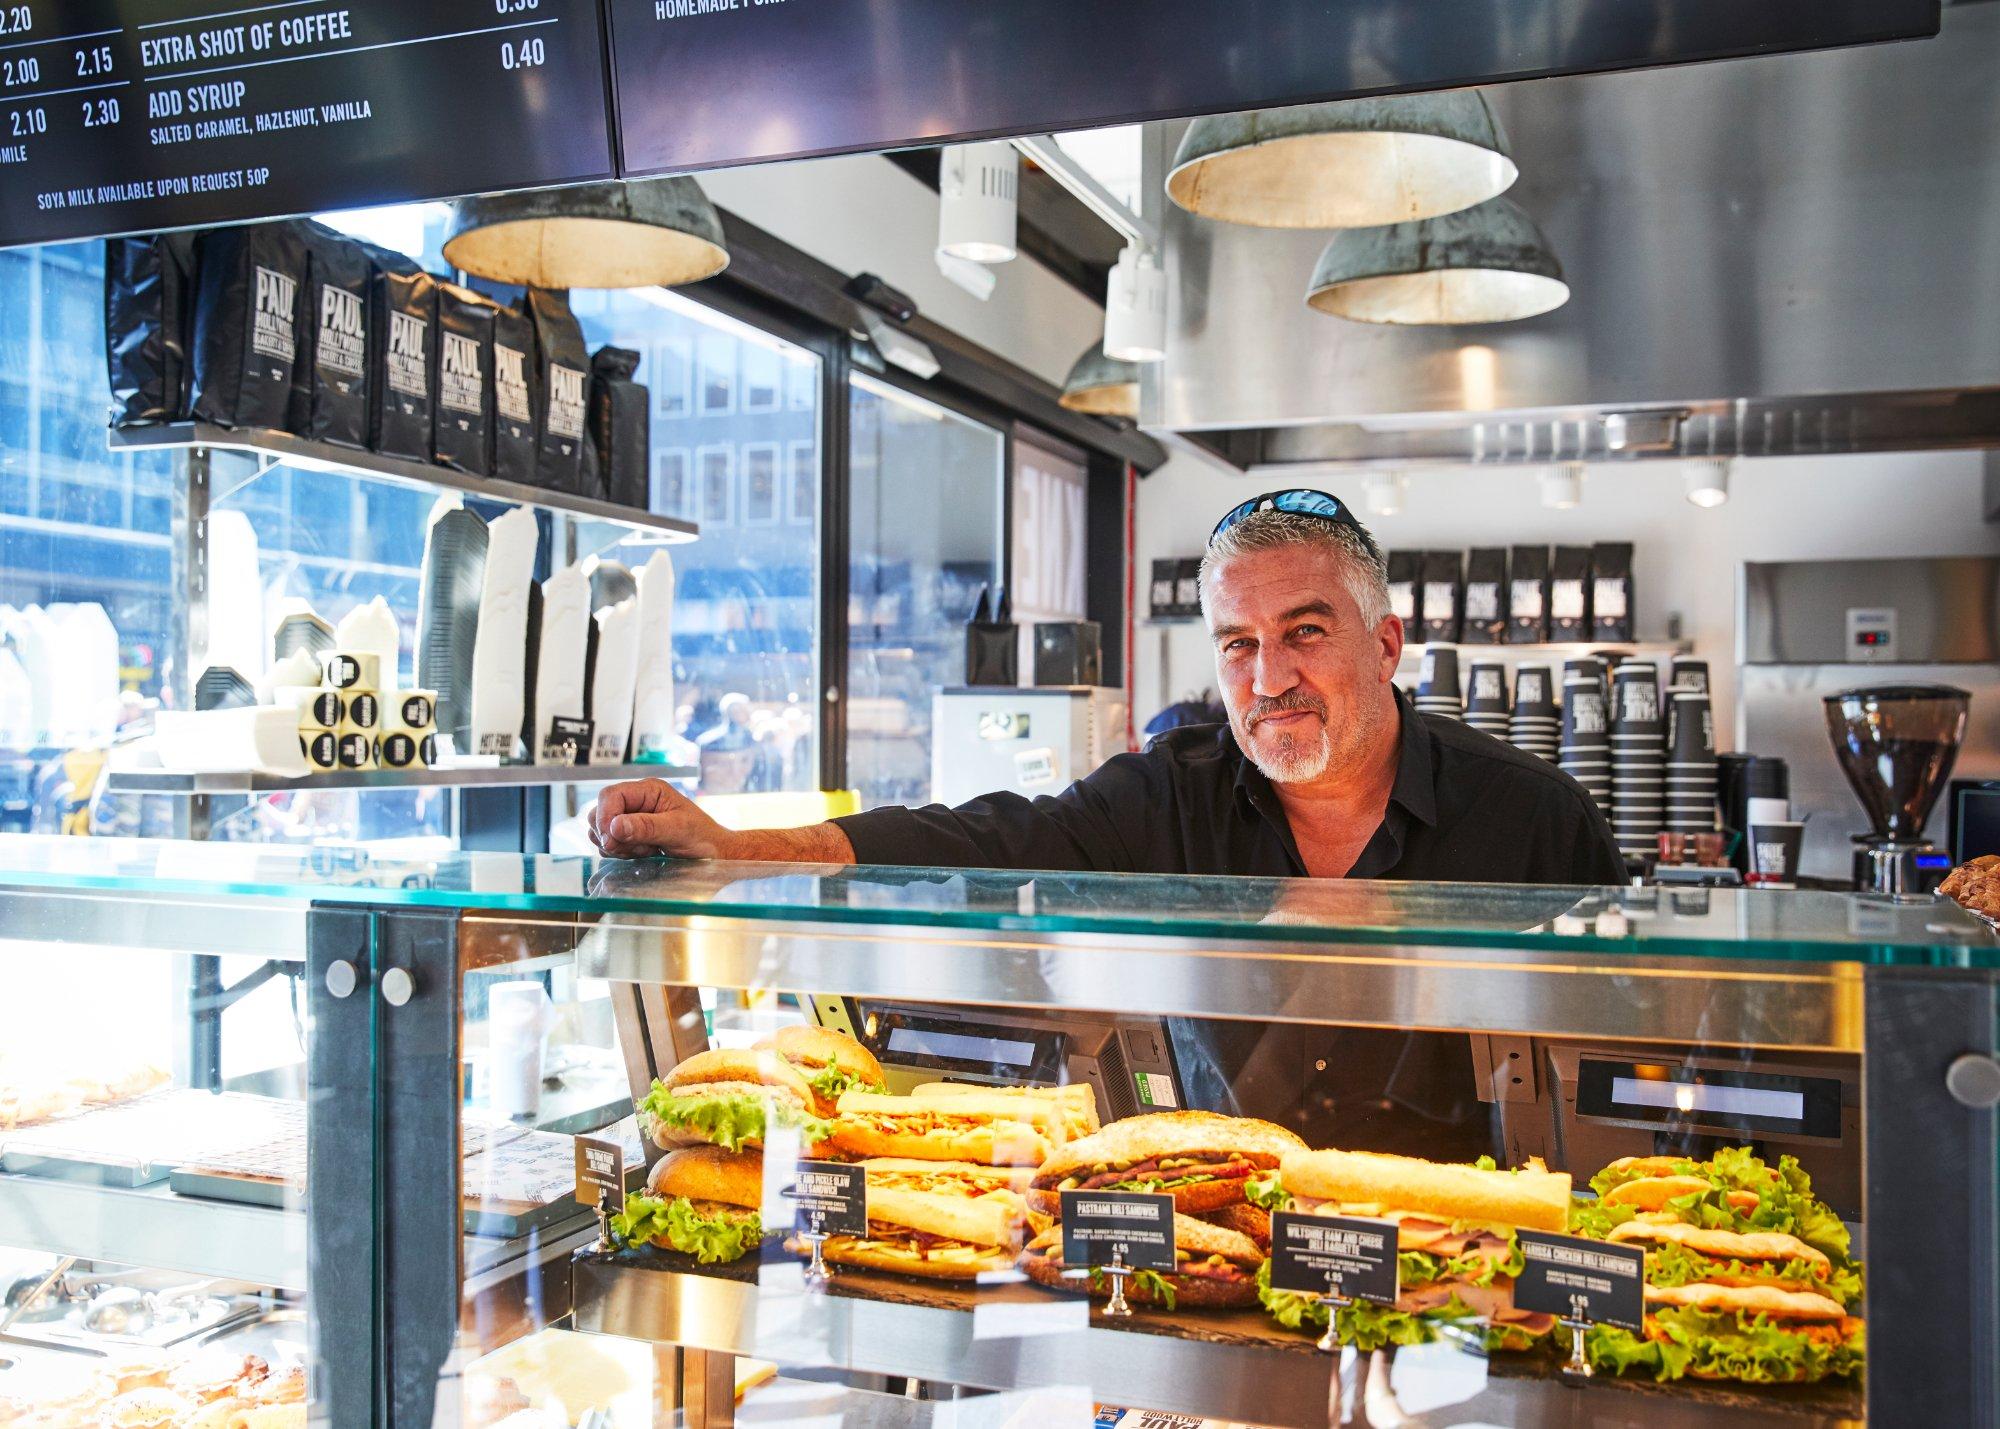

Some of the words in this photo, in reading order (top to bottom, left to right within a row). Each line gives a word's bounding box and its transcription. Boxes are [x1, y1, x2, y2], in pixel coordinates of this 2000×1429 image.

[0, 6, 32, 34] 2.20
[141, 35, 196, 67] EXTRA
[199, 27, 245, 58] SHOT
[250, 22, 273, 50] OF
[280, 11, 352, 46] COFFEE
[501, 38, 545, 70] 0.40
[4, 58, 39, 86] 2.00
[76, 47, 113, 76] 2.15
[149, 90, 182, 118] ADD
[188, 81, 245, 113] SYRUP
[11, 108, 47, 136] 2.10
[82, 99, 120, 127] 2.30
[151, 125, 191, 145] SALTED
[196, 117, 253, 139] CARAMEL,
[256, 108, 319, 132] HAZLENUT,
[321, 101, 371, 122] VANILLA
[38, 192, 65, 210] SOYA
[68, 188, 95, 207] MILK
[98, 181, 154, 203] AVAILABLE
[157, 177, 189, 196] UPON
[192, 170, 243, 192] REQUEST
[247, 168, 269, 186] 50P
[257, 271, 294, 322] PAUL
[321, 289, 365, 338] PAUL
[320, 328, 364, 354] HOLLYWOOD
[389, 316, 425, 360] PAUL
[442, 337, 482, 378] PAUL
[550, 369, 585, 406] PAUL
[809, 1184, 837, 1195] SANDWICH
[815, 1175, 833, 1186] PICKLE
[834, 1176, 850, 1188] SLAW
[1077, 1203, 1111, 1215] PASTRAMI
[1111, 1204, 1124, 1215] DELI
[1125, 1205, 1159, 1217] SANDWICH
[1287, 1226, 1324, 1240] WILTSHIRE
[1324, 1229, 1342, 1242] HAM
[1343, 1232, 1357, 1245] AND
[1358, 1234, 1384, 1250] CHEESE
[1308, 1239, 1324, 1250] DELI
[1324, 1240, 1360, 1256] BAGUETTE
[1553, 1247, 1582, 1263] CHICKEN
[1583, 1251, 1598, 1266] DELI
[1599, 1254, 1638, 1274] SANDWICH
[1324, 1271, 1343, 1283] 4.95
[1569, 1294, 1589, 1308] 4.95
[1143, 1410, 1204, 1426] HOLLYWOOD
